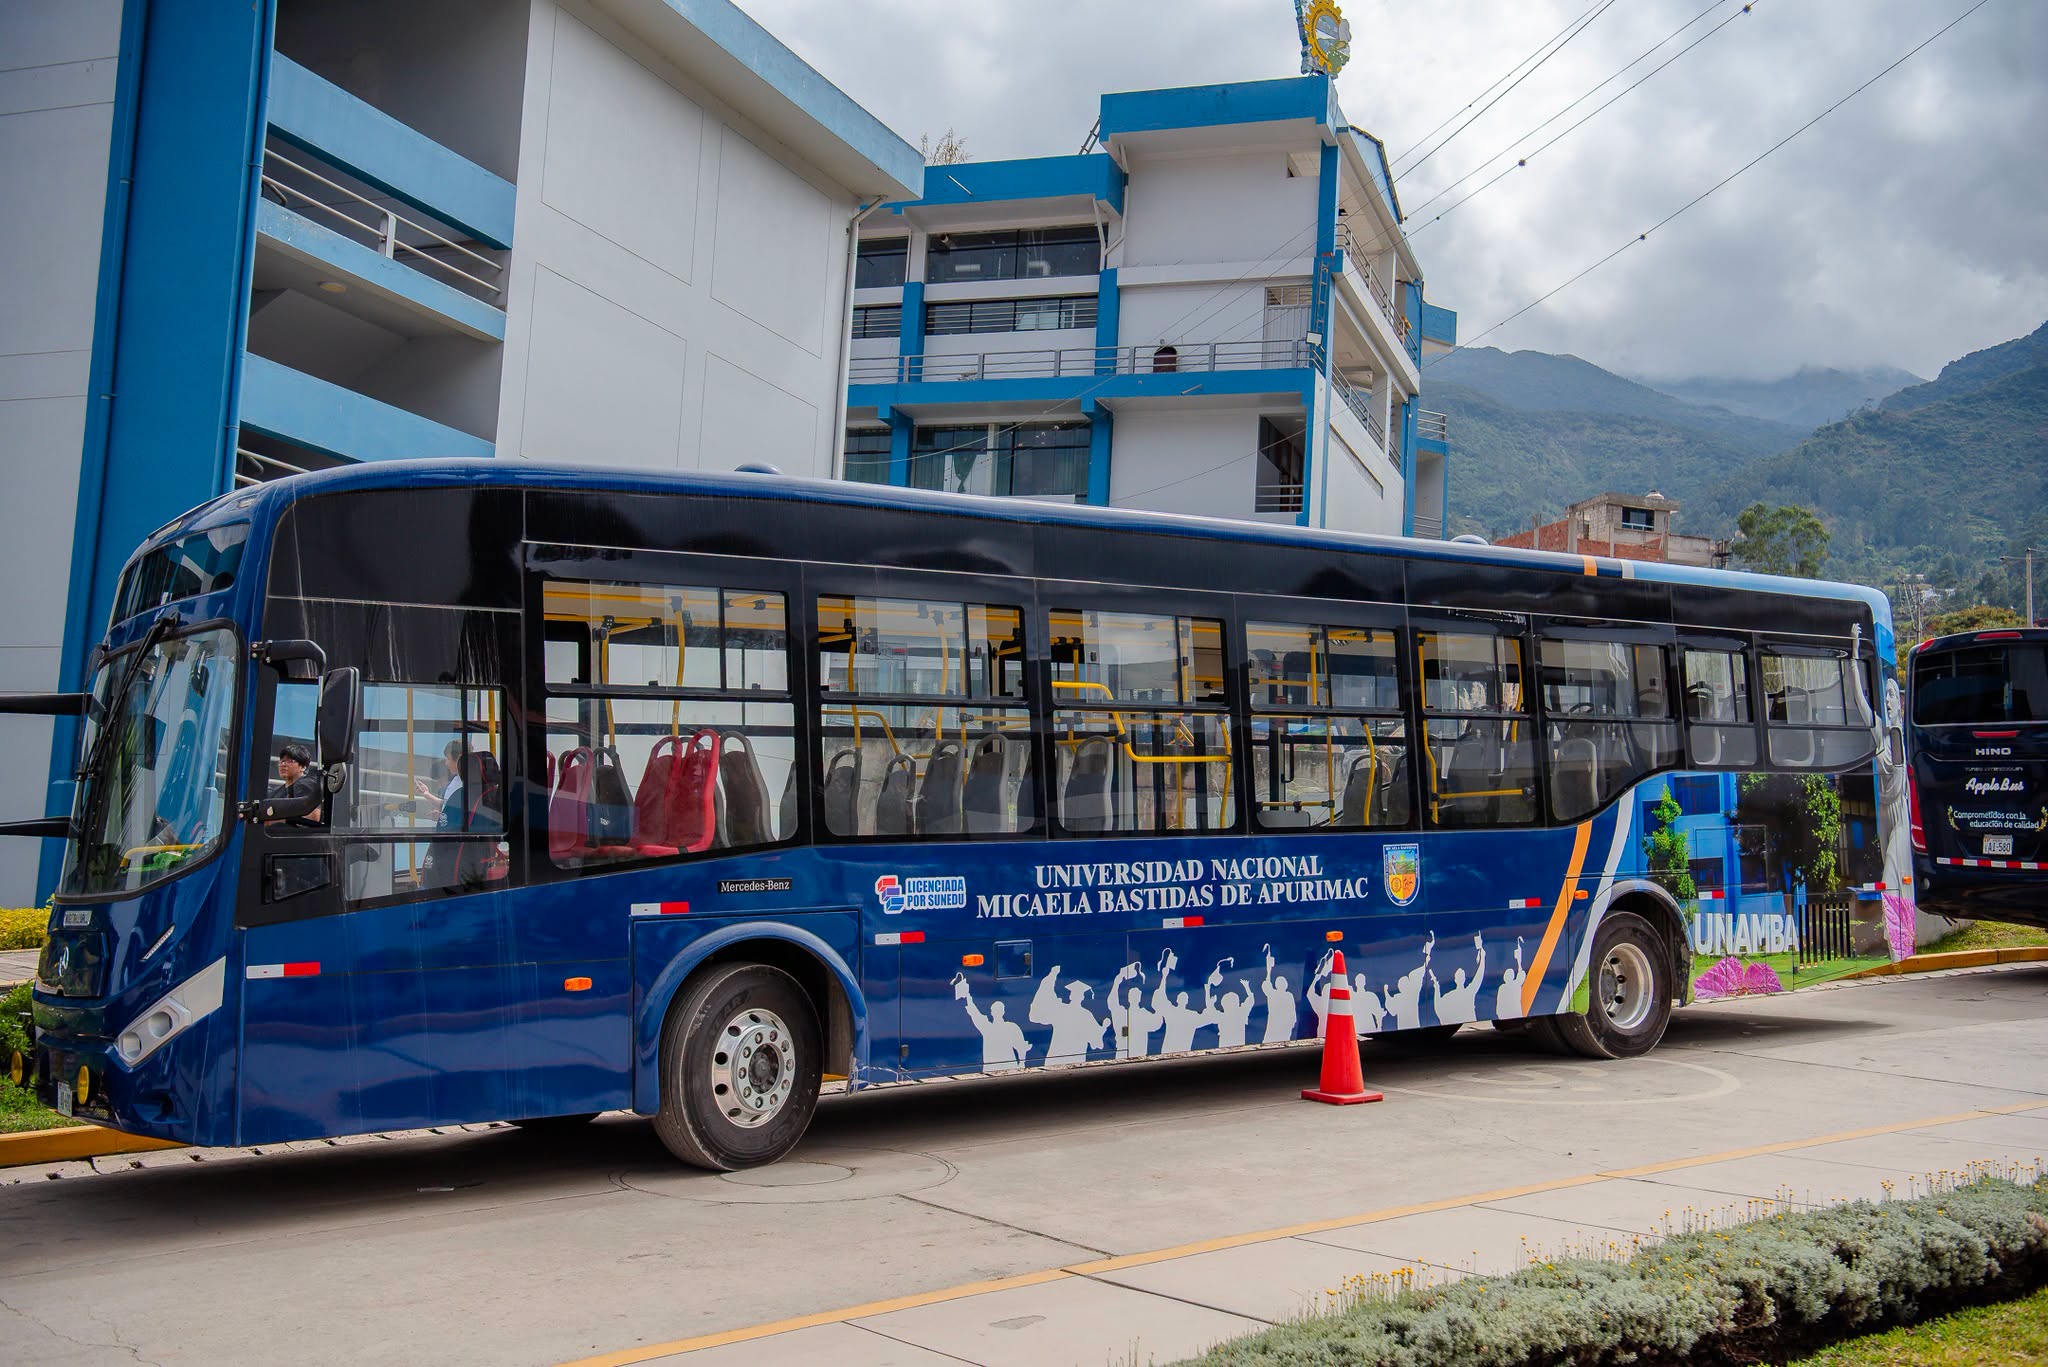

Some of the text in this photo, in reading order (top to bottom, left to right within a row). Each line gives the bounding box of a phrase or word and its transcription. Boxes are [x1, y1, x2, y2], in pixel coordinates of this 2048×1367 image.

[1975, 747, 2012, 756] HINO
[1953, 810, 2005, 820] Comprometidos
[2019, 811, 2027, 820] la
[1969, 819, 2040, 829] educación de calidad
[1035, 855, 1323, 889] UNIVERSIDAD NACIONAL
[720, 880, 790, 893] Mercedes-Benz
[907, 879, 964, 893] LICENCIADA
[907, 893, 964, 907] POR SUNEDU
[976, 877, 1369, 919] MICAELA BASTIDAS DE APURIMAC
[1693, 912, 1800, 955] UNAMBA
